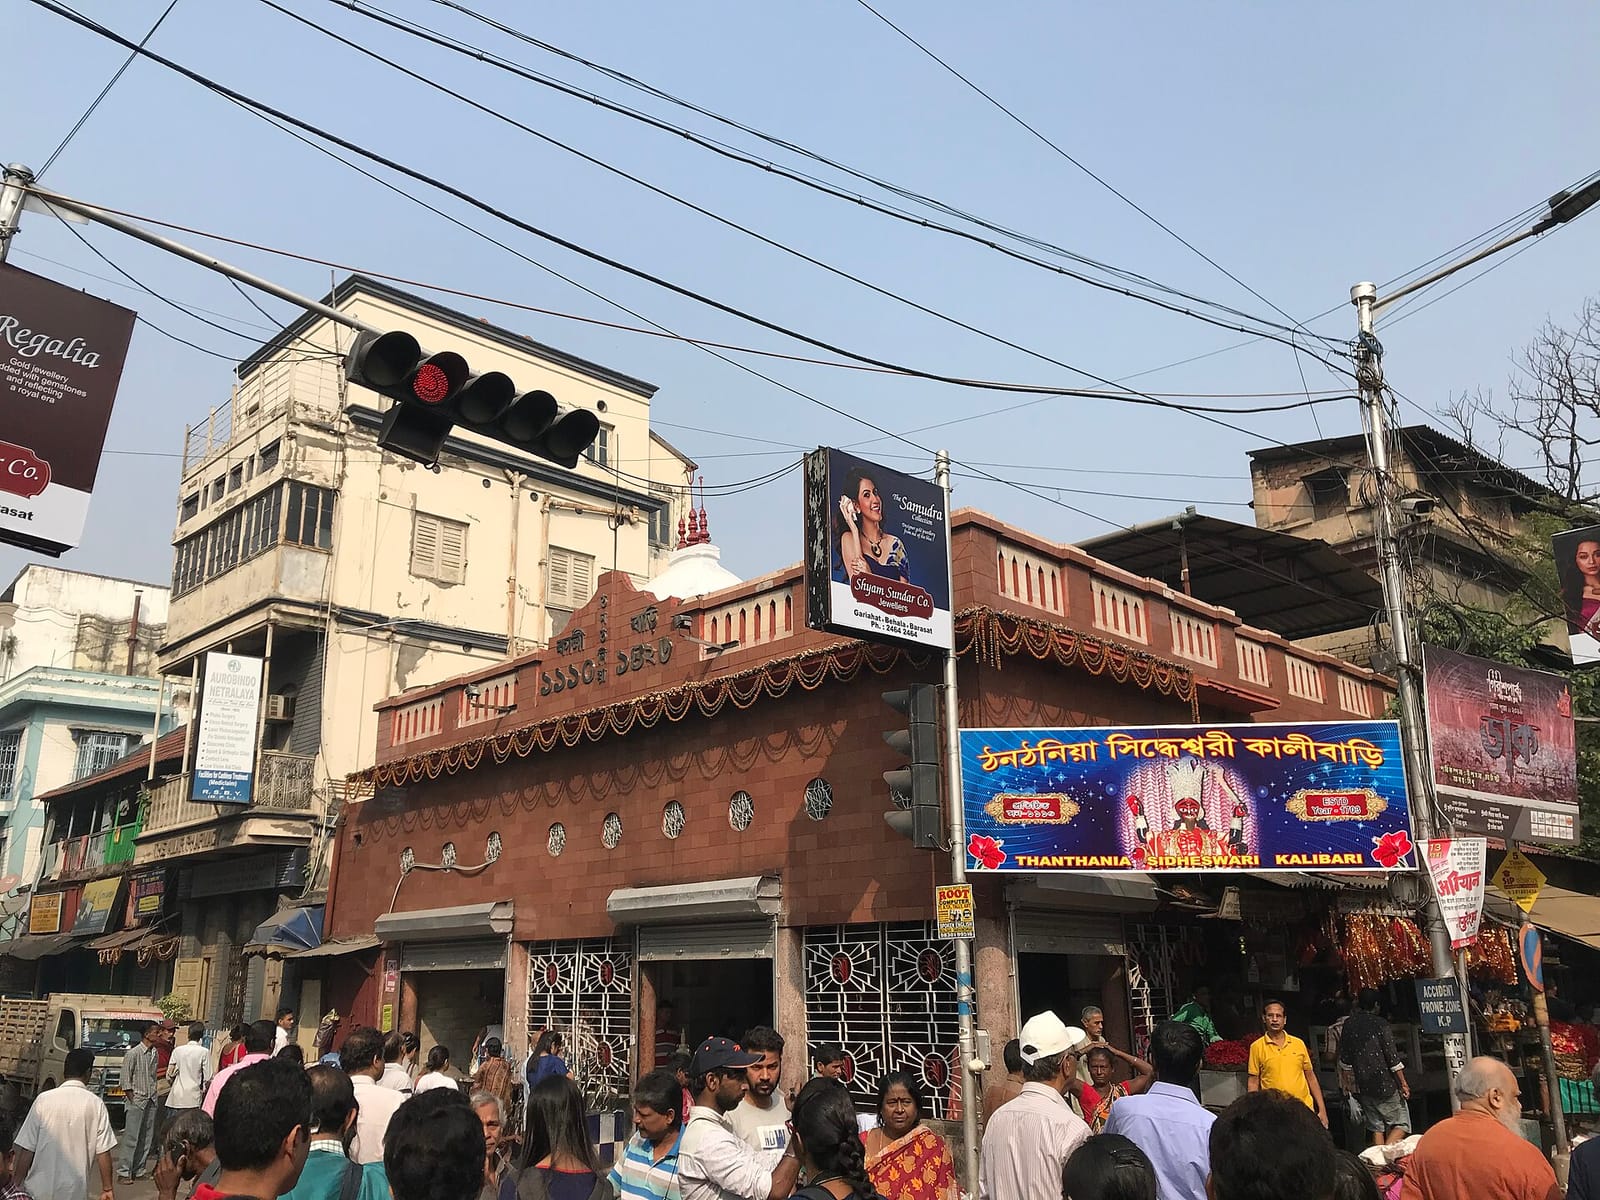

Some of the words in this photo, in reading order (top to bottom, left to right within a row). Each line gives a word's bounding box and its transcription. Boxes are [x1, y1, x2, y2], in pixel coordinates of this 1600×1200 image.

[0, 315, 100, 368] Regalia
[9, 357, 31, 370] Gold
[31, 365, 69, 384] jewellery
[6, 374, 24, 384] and
[25, 380, 63, 399] reflecting
[22, 371, 40, 382] with
[41, 378, 87, 397] gemstones
[18, 387, 40, 399] royal
[41, 395, 55, 404] era
[7, 459, 39, 481] Co.
[899, 496, 943, 521] Samudra
[854, 578, 885, 597] Shyam
[885, 586, 915, 604] Sundar
[916, 595, 931, 608] Co.
[878, 597, 909, 613] Jewellers
[556, 629, 586, 656] কালী
[210, 672, 257, 688] AUROBINDO
[209, 686, 255, 701] NETRALAYA
[977, 739, 1099, 773] ঠনঠনিয়া
[1104, 730, 1238, 760] সিদ্ধেশ্বরী
[1241, 732, 1386, 770] কালীবাড়ি
[1323, 796, 1349, 806] ESTD
[1311, 805, 1333, 815] Year
[1015, 854, 1133, 867] THANTHANIA
[1147, 854, 1261, 867] SIDHESWARI
[1274, 853, 1364, 866] KALIBARI
[939, 889, 969, 900] ROOT
[1423, 985, 1454, 998] ACCIDENT
[1421, 1001, 1445, 1014] PRONE
[1445, 1000, 1462, 1013] ZONE
